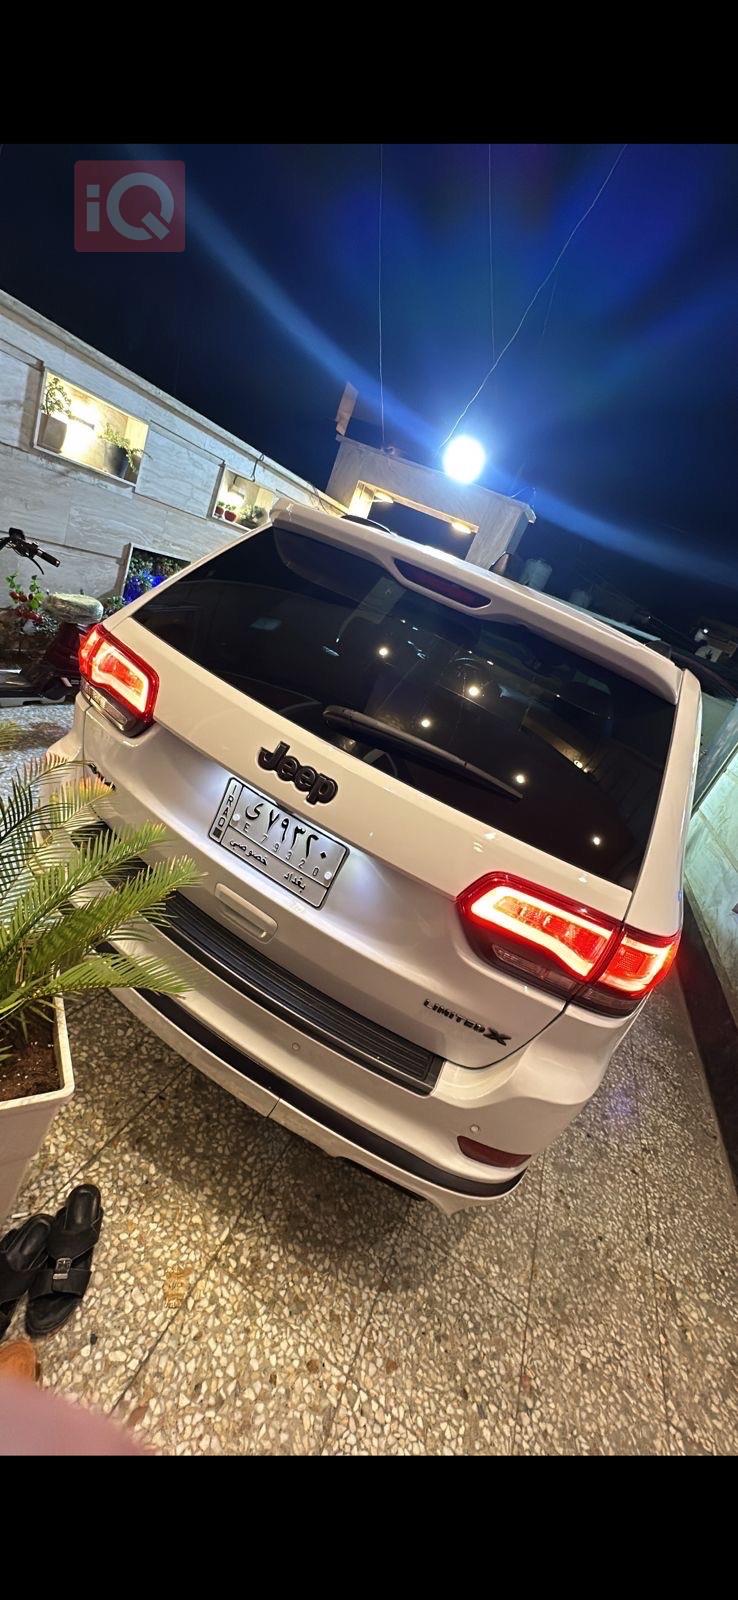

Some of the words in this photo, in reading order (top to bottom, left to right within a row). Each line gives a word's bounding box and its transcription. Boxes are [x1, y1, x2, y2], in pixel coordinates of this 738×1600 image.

[258, 741, 338, 805] Jeep
[218, 785, 237, 827] IRAQ
[284, 871, 306, 893] بغداد
[423, 999, 485, 1033] LIMITED
